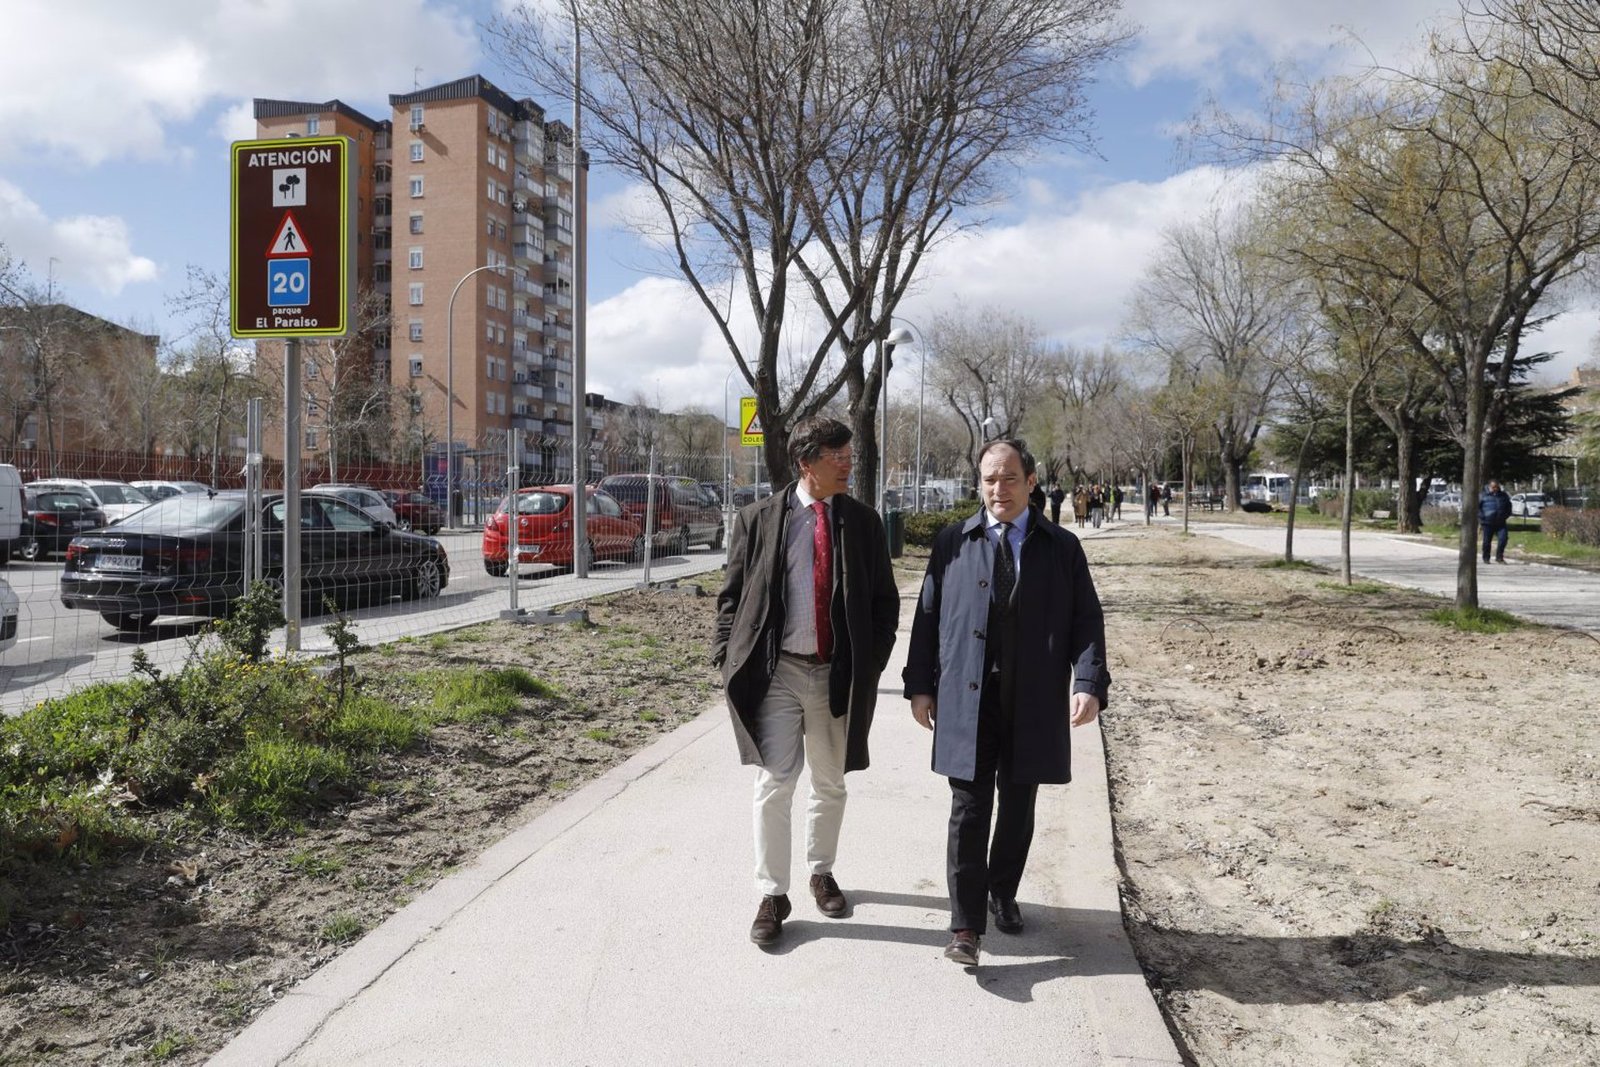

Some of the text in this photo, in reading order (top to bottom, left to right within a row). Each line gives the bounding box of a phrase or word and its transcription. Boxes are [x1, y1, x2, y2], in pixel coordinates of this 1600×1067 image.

[248, 147, 332, 168] ATENCIÓN
[273, 272, 305, 294] 20
[272, 307, 302, 315] parque
[256, 317, 268, 328] El
